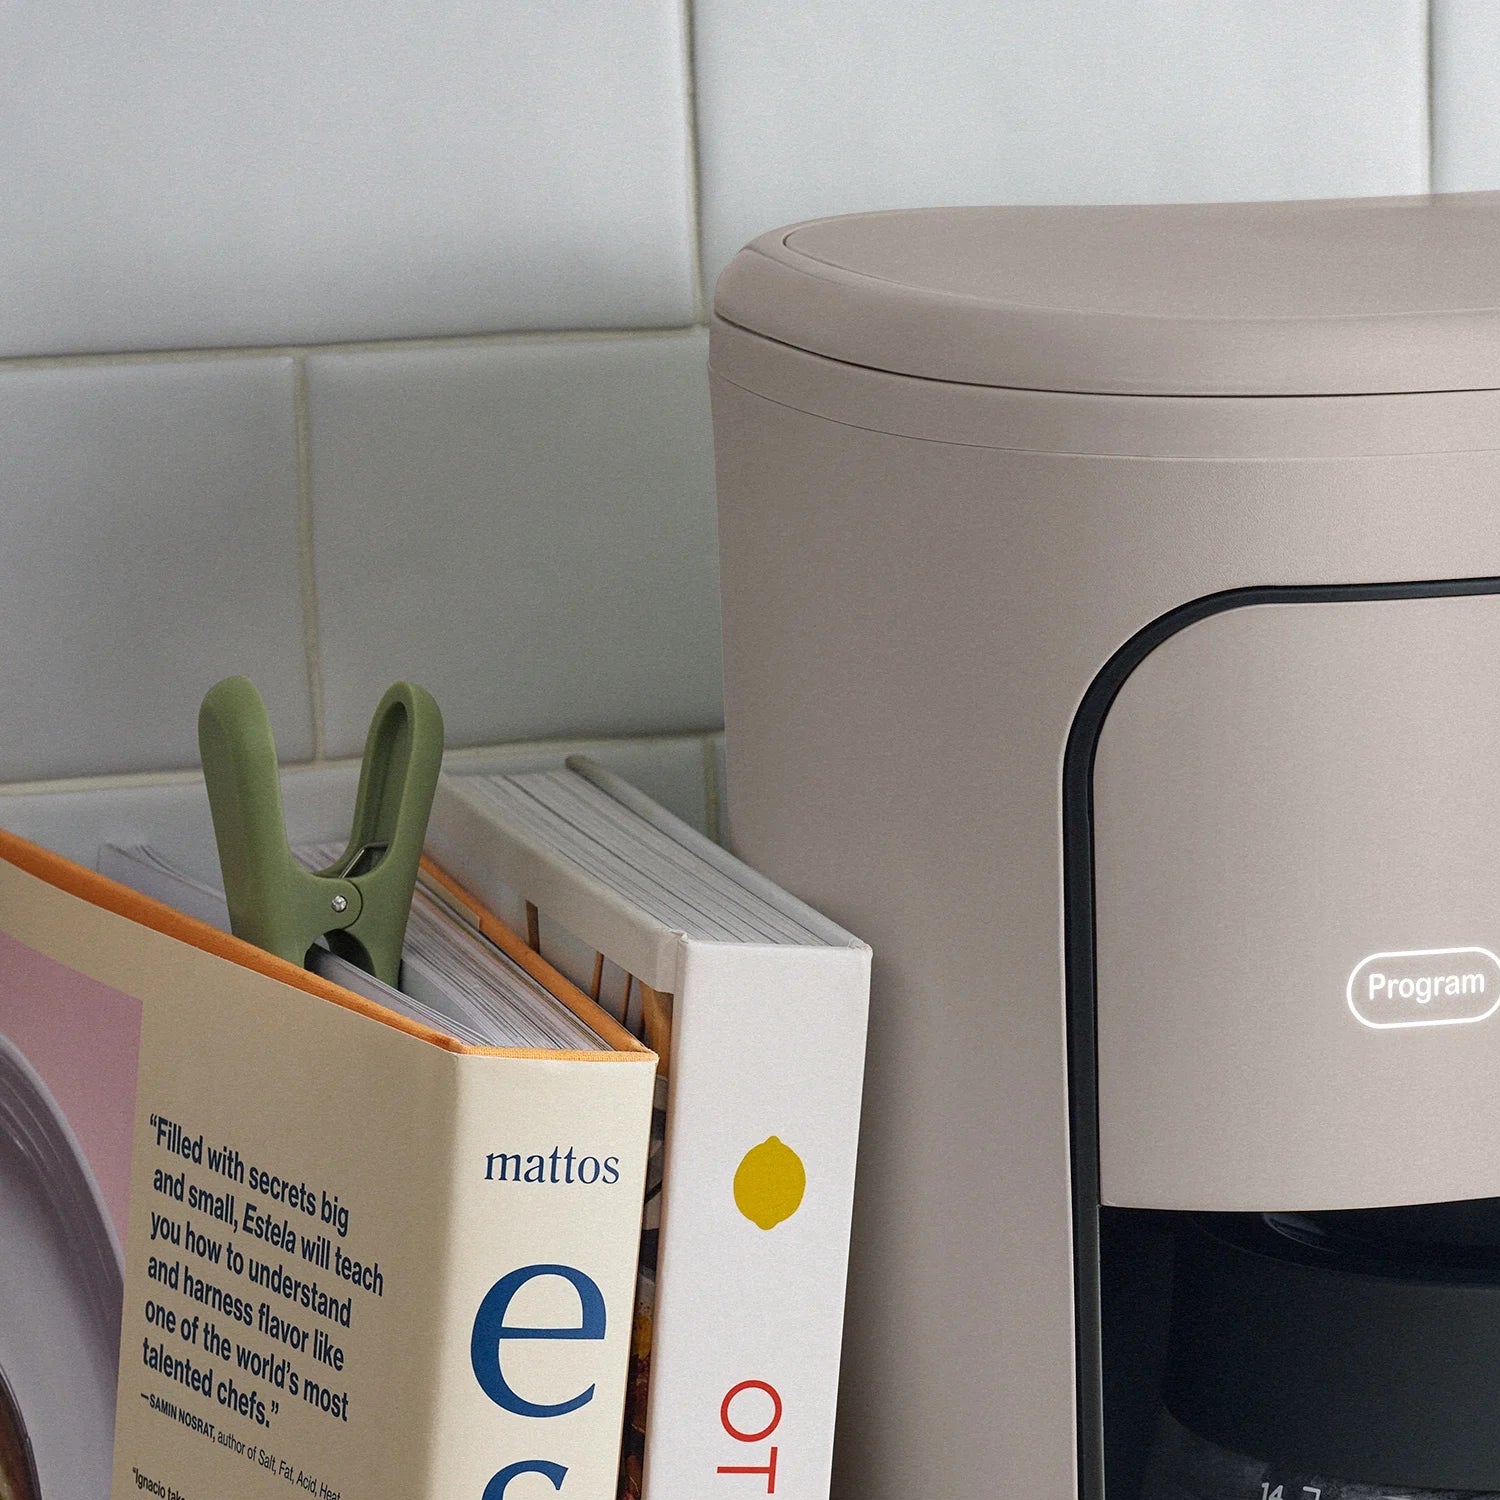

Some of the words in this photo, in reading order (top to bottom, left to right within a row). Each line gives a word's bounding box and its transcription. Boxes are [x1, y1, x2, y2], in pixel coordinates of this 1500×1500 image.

[1369, 974, 1484, 1003] Program
[208, 1146, 244, 1184] with
[249, 1167, 316, 1216] secrets
[321, 1190, 349, 1238] big
[484, 1146, 619, 1184] mattos
[151, 1211, 181, 1246] you
[185, 1221, 222, 1264] how
[226, 1242, 244, 1275] to
[249, 1258, 352, 1328] understand
[153, 1169, 185, 1202] and
[188, 1185, 238, 1233] small,
[242, 1202, 296, 1254] Estela
[301, 1235, 331, 1270] will
[335, 1246, 383, 1297] teach
[145, 1300, 176, 1333] one
[180, 1316, 199, 1344] of
[203, 1322, 231, 1361] the
[303, 1378, 349, 1422] most
[148, 1256, 179, 1291] and
[183, 1265, 253, 1326] harness
[258, 1302, 309, 1353] flavor
[313, 1328, 344, 1371] like
[143, 1337, 213, 1398] talented
